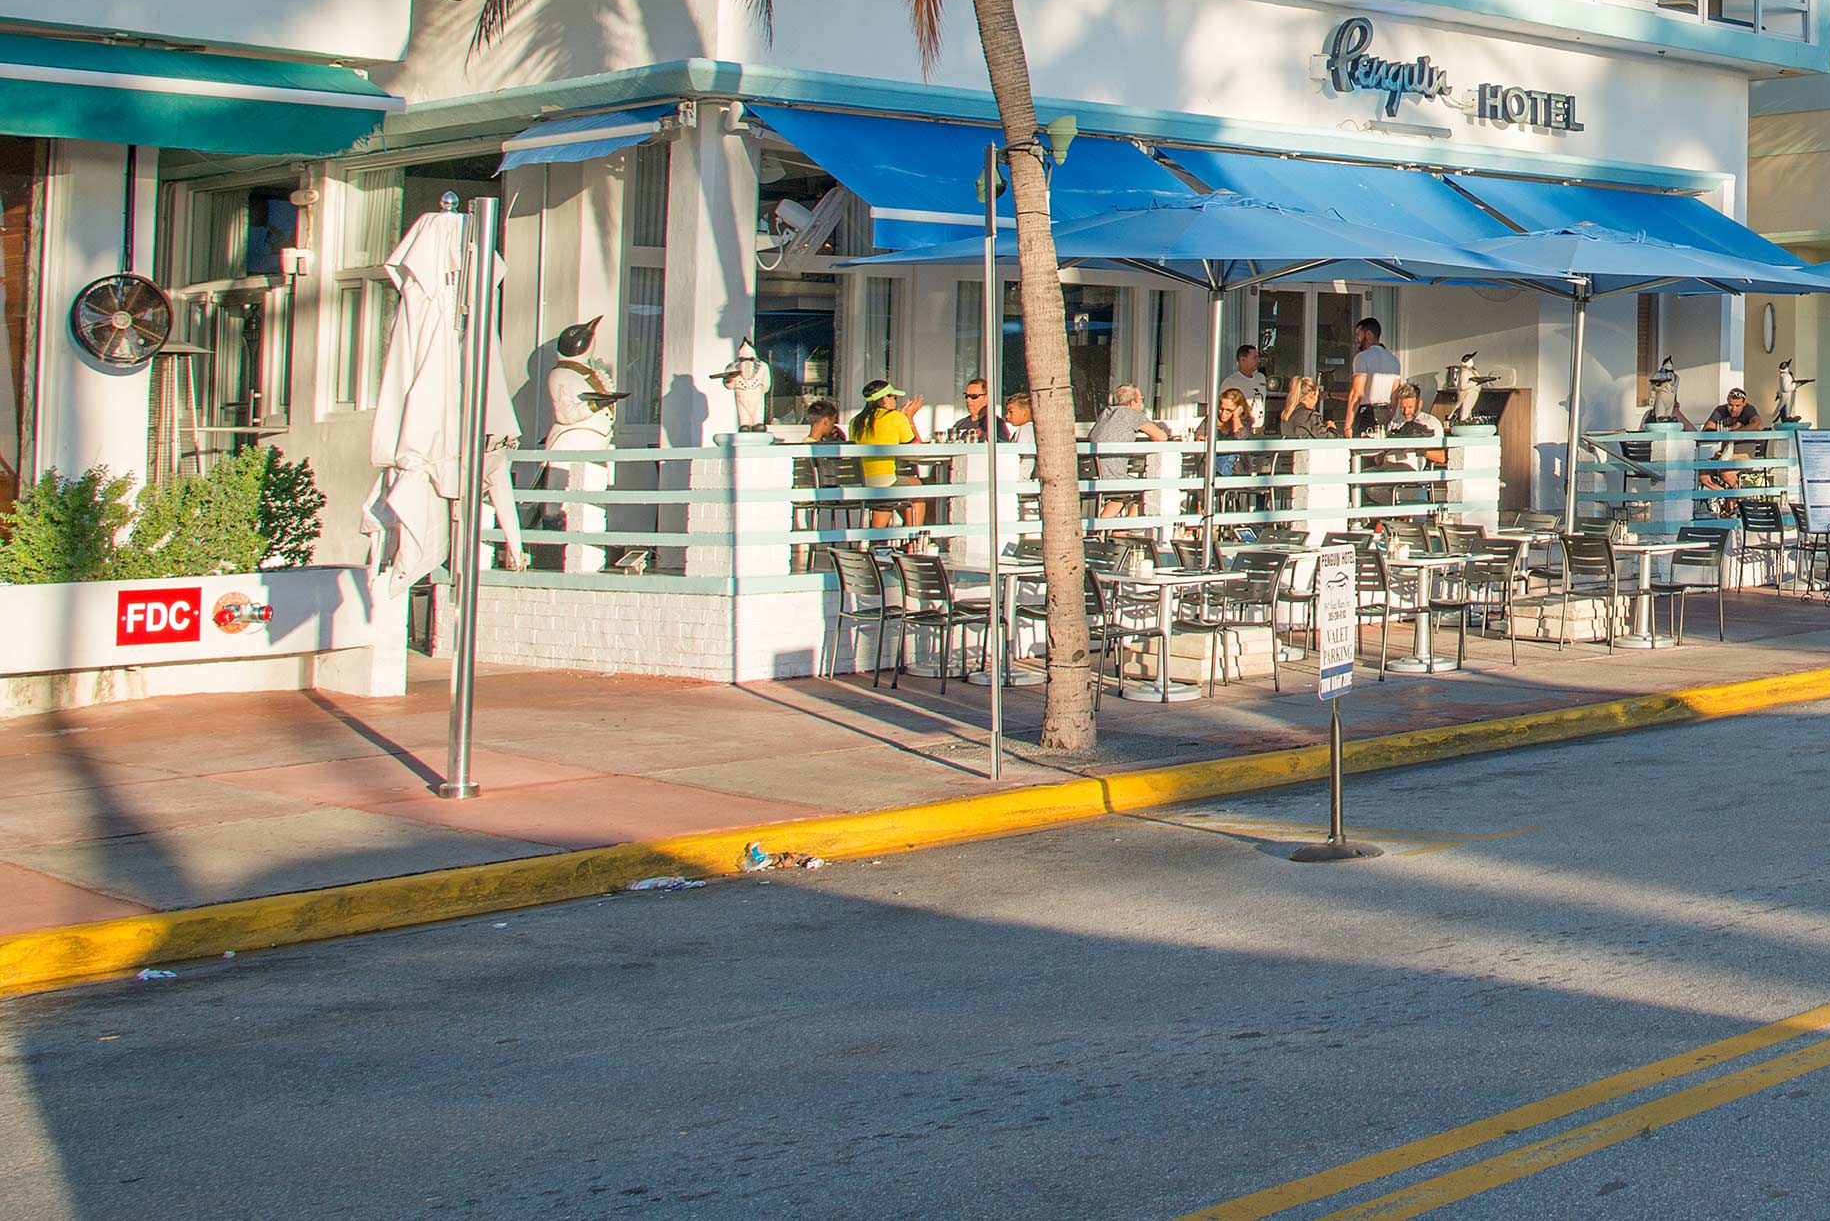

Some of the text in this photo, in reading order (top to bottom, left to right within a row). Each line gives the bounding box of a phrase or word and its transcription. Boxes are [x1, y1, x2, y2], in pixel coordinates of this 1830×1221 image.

[1330, 16, 1585, 132] Penguin HOTEL
[1321, 551, 1355, 568] PENGUIN HOTEL
[126, 600, 191, 634] FDC
[1327, 626, 1349, 644] VALET
[1323, 644, 1353, 666] PARKING
